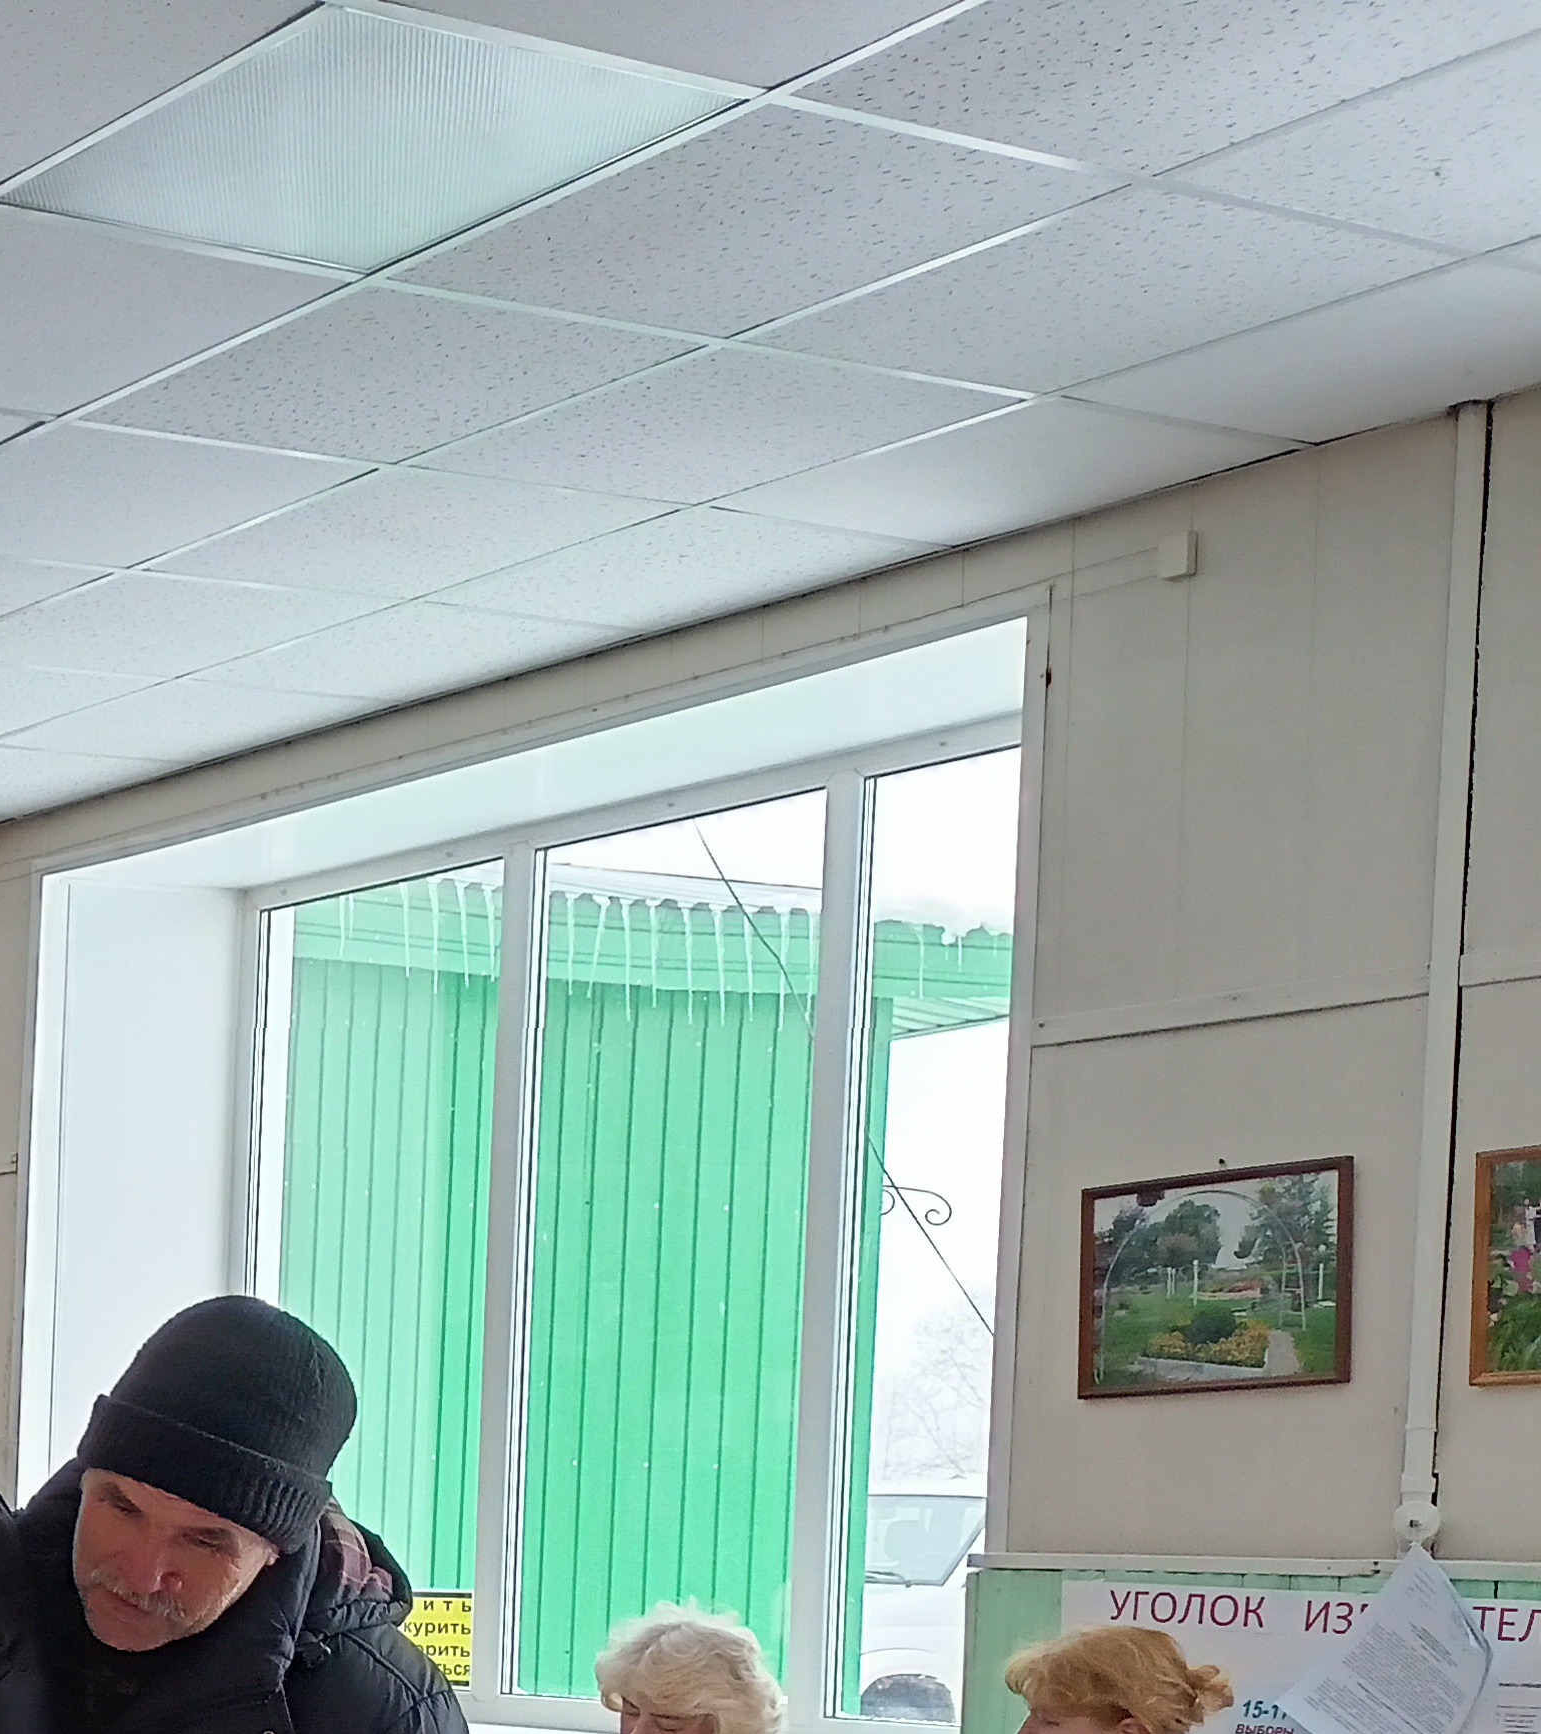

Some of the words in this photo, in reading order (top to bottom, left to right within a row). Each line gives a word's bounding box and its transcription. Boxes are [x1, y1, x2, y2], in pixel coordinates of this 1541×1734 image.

[1110, 1589, 1266, 1628] УГОЛОК
[404, 1622, 471, 1637] курить
[415, 1644, 470, 1657] орить
